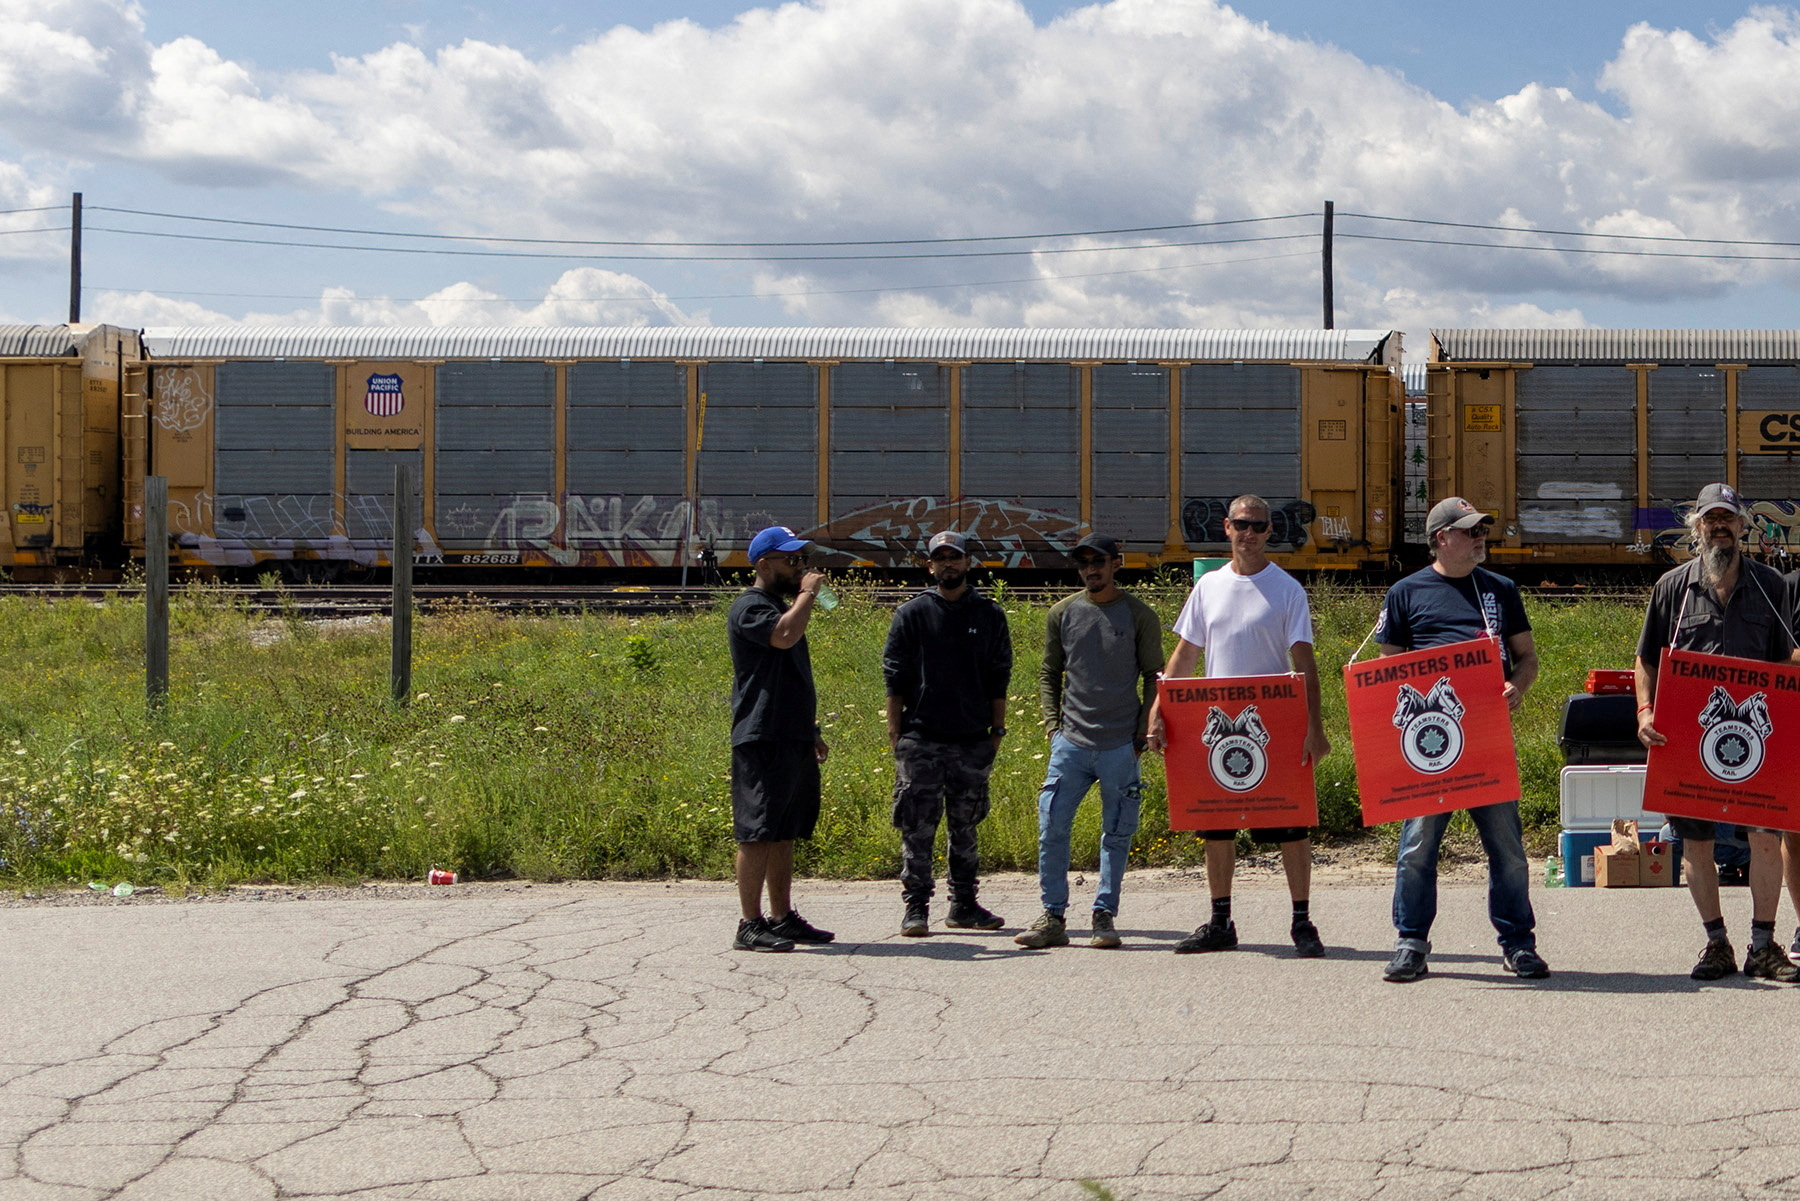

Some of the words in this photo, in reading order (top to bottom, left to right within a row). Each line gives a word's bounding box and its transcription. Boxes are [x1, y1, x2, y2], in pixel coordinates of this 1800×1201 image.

[462, 554, 518, 564] 852688
[1354, 655, 1449, 688] TEAMSTERS
[1453, 648, 1492, 670] RAIL
[1670, 659, 1770, 688] TEAMSTERS
[1166, 685, 1256, 703] TEAMSTERS
[1260, 684, 1298, 700] RAIL
[1410, 715, 1449, 732] TEAMSTERS
[1714, 724, 1754, 741] TEAMSTERS
[1218, 739, 1255, 752] TEAMSTERS
